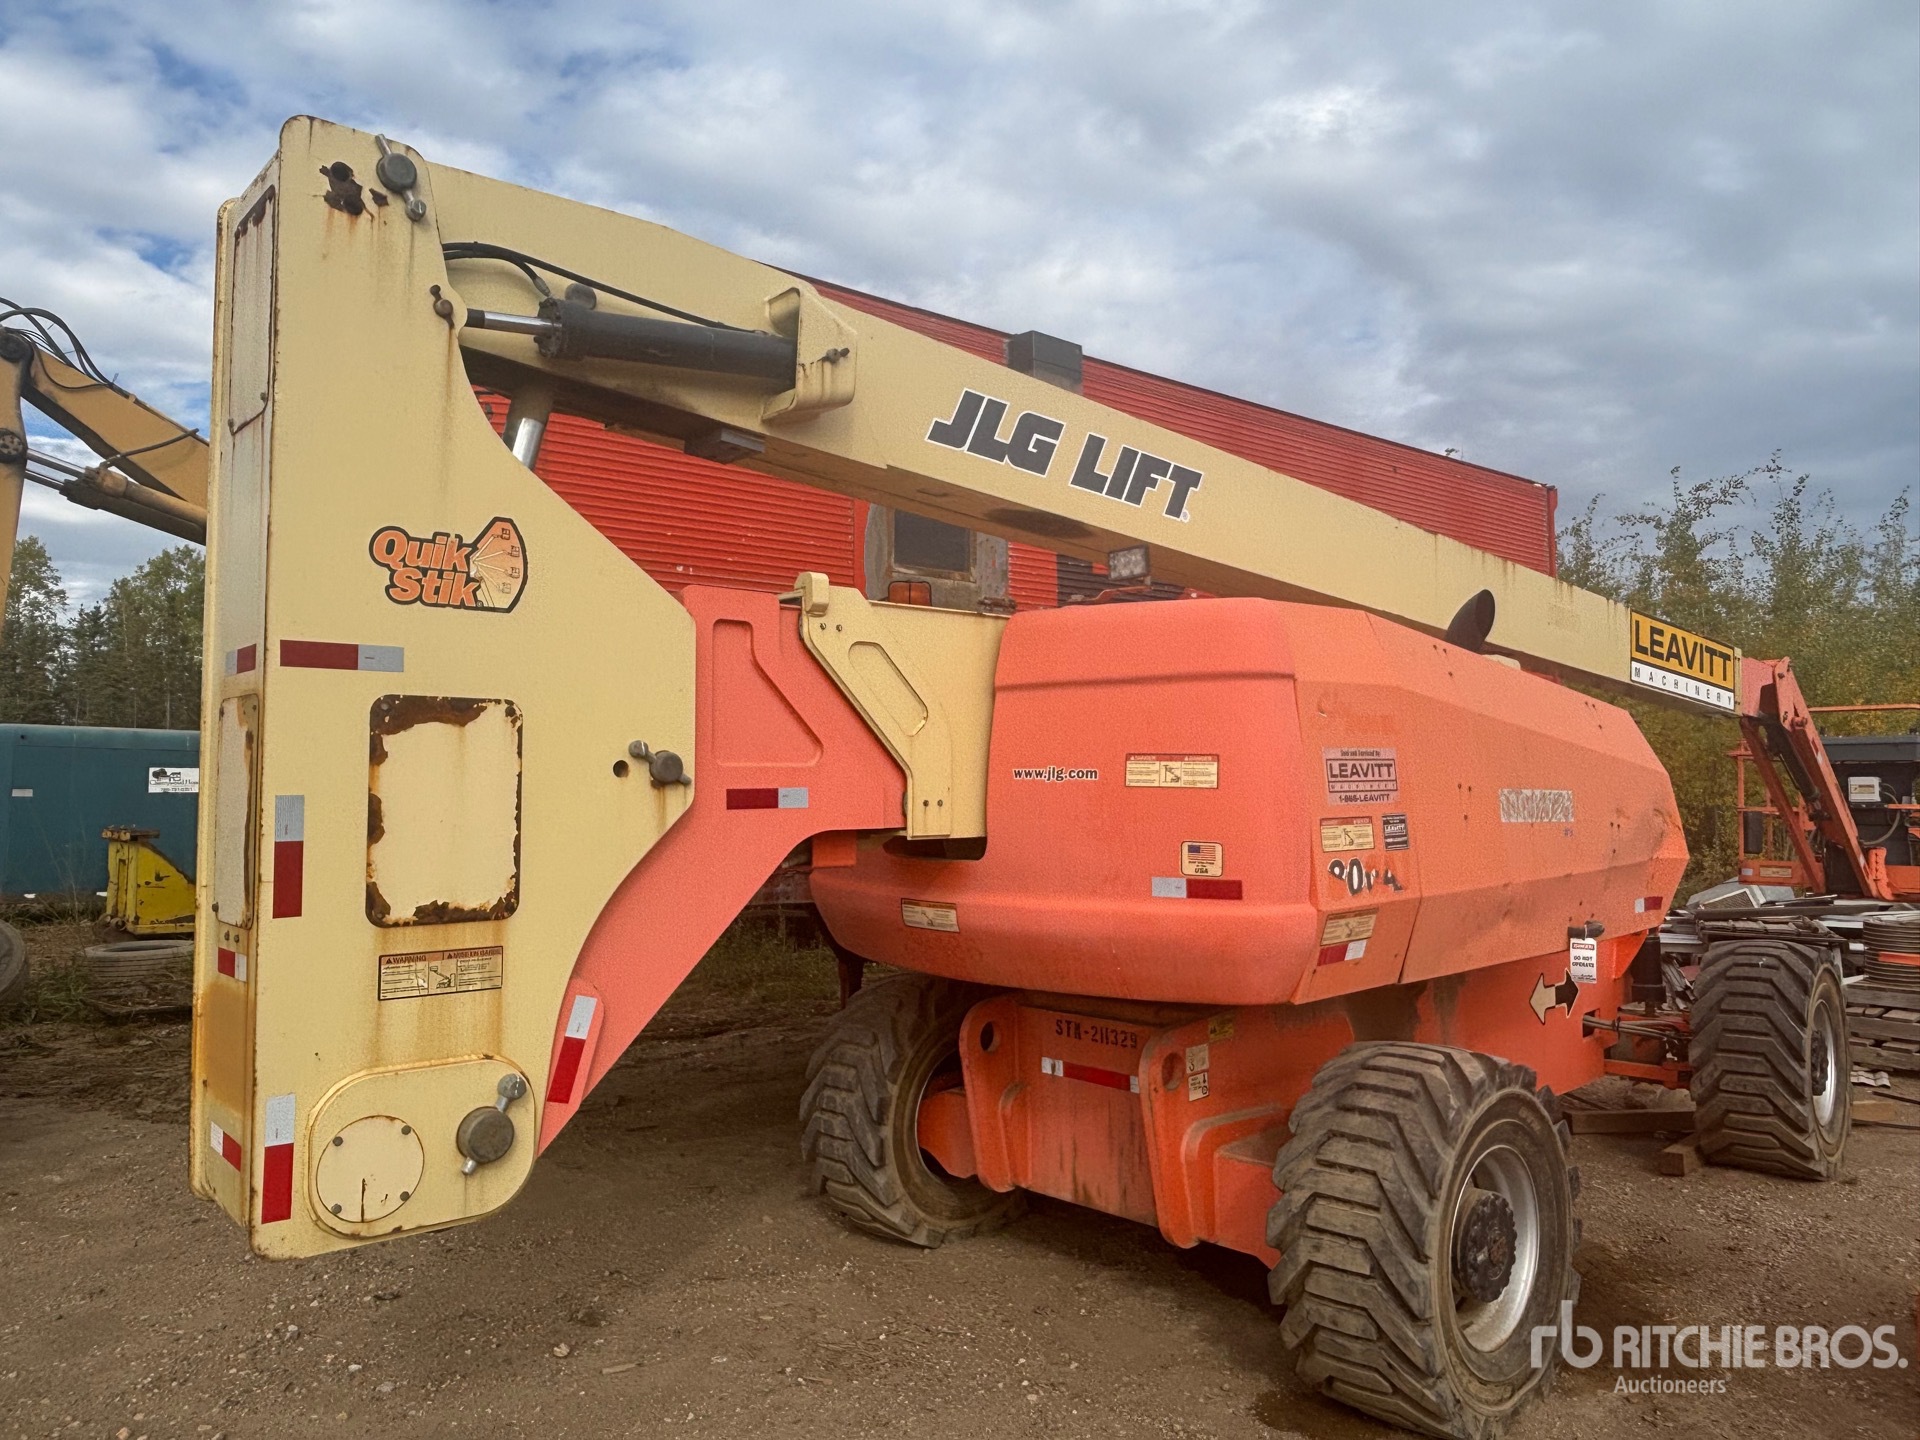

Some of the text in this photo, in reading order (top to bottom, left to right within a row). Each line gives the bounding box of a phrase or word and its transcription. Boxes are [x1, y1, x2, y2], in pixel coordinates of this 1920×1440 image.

[926, 388, 1204, 521] JLG LIFT
[373, 530, 472, 572] Quik
[389, 567, 480, 607] Stik
[1635, 620, 1731, 682] LEAVITT
[1634, 667, 1731, 706] MACHINERY
[1013, 766, 1098, 782] www.jlg.com
[1329, 763, 1393, 778] LEAVITT
